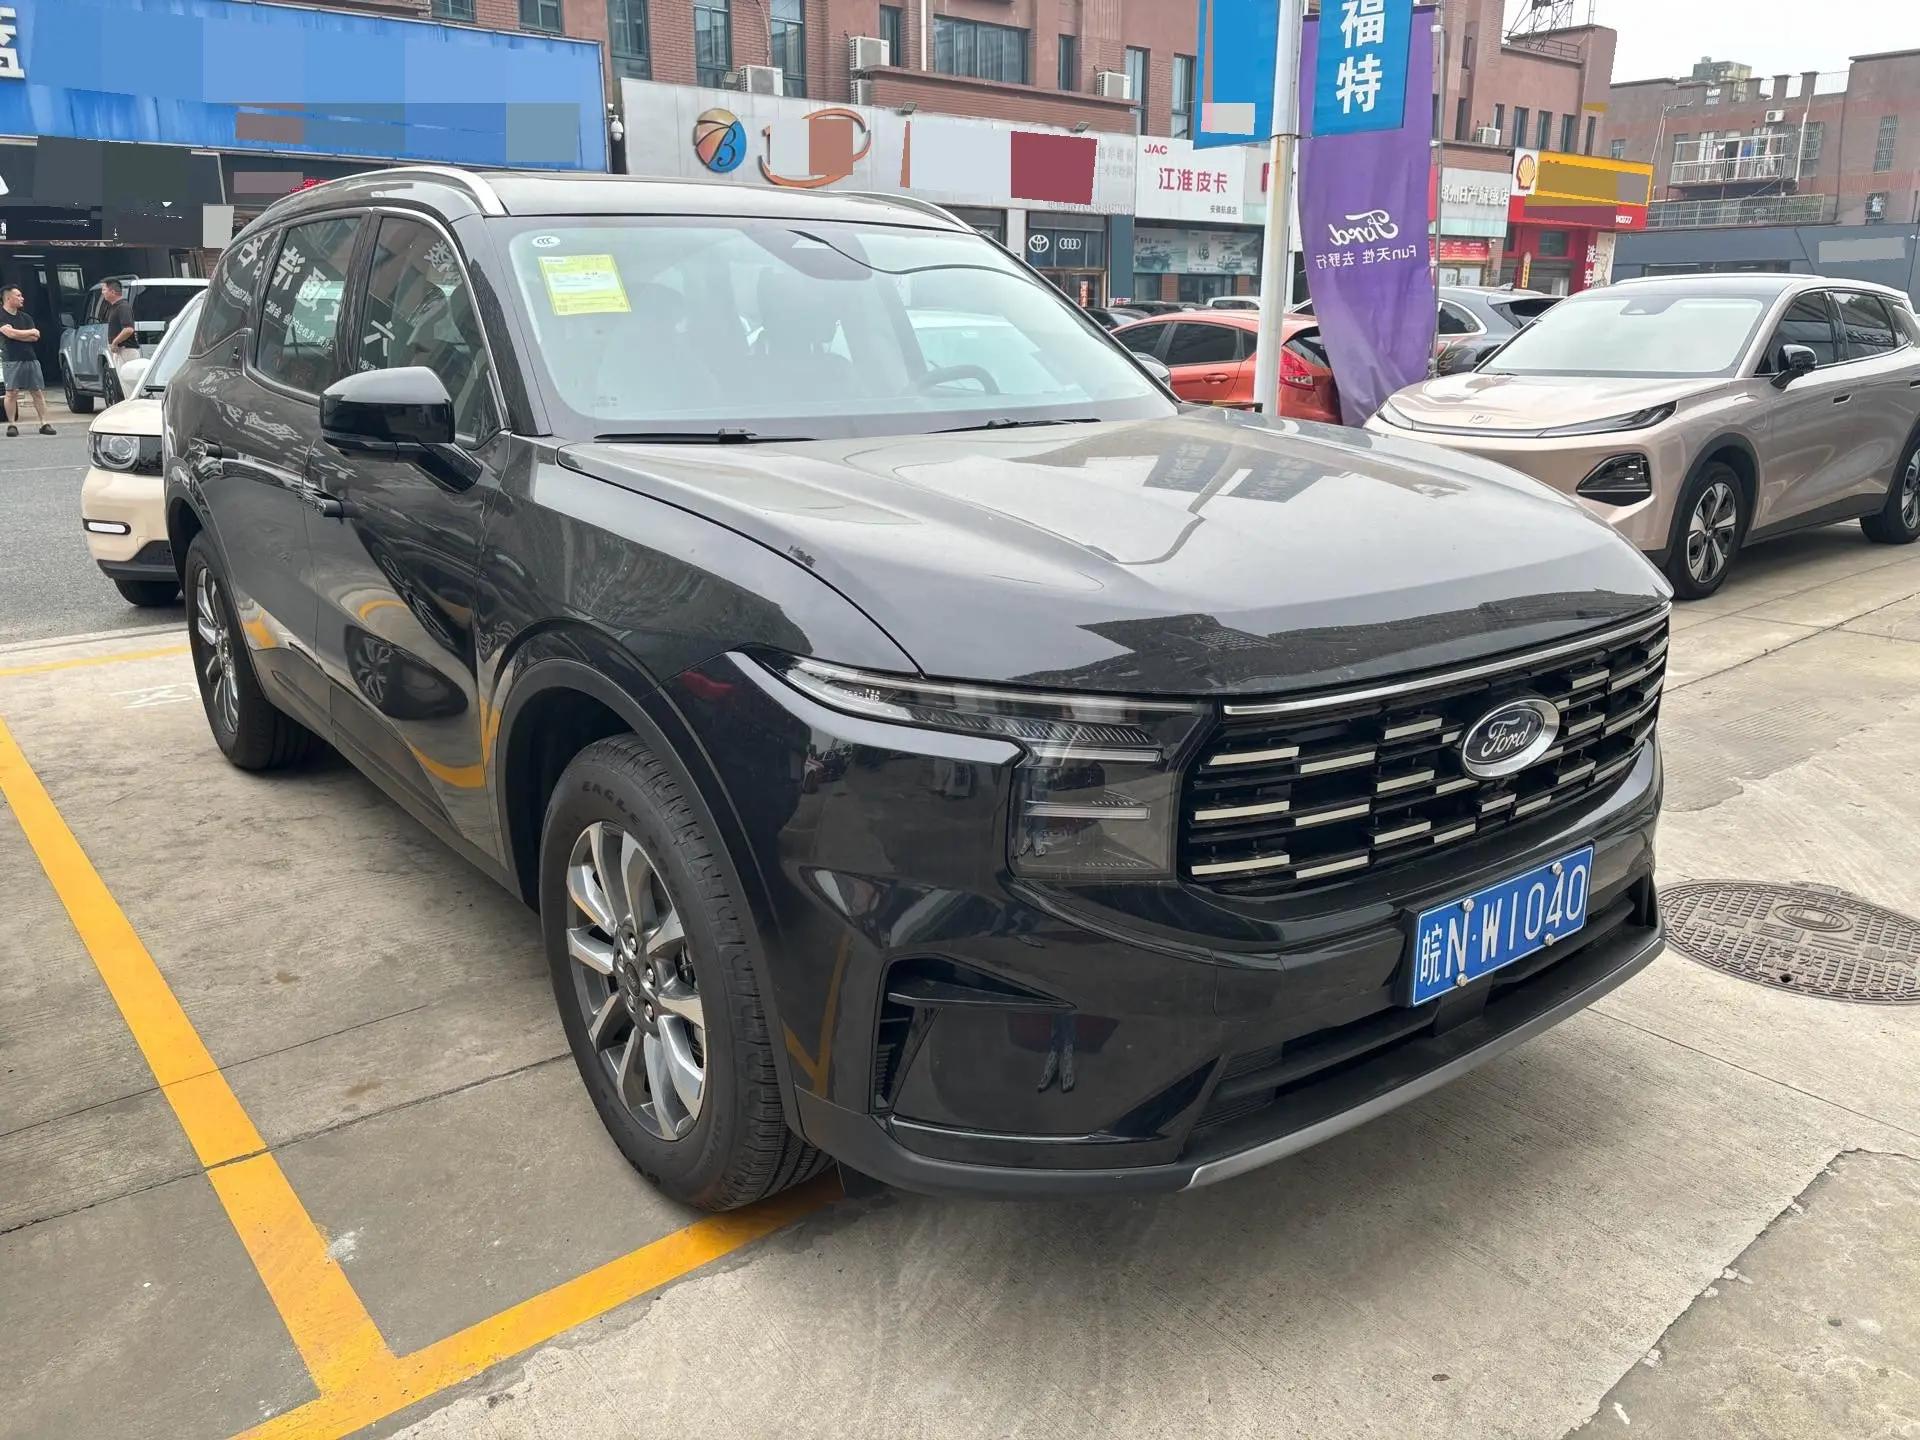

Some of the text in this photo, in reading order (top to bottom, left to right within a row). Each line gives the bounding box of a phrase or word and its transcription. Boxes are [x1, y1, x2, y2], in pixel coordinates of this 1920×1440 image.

[1335, 0, 1385, 114] 福特
[1144, 143, 1168, 155] JAC
[1158, 167, 1228, 194] 江淮皮卡
[1583, 244, 1599, 287] 洗车
[1480, 715, 1530, 758] Ford
